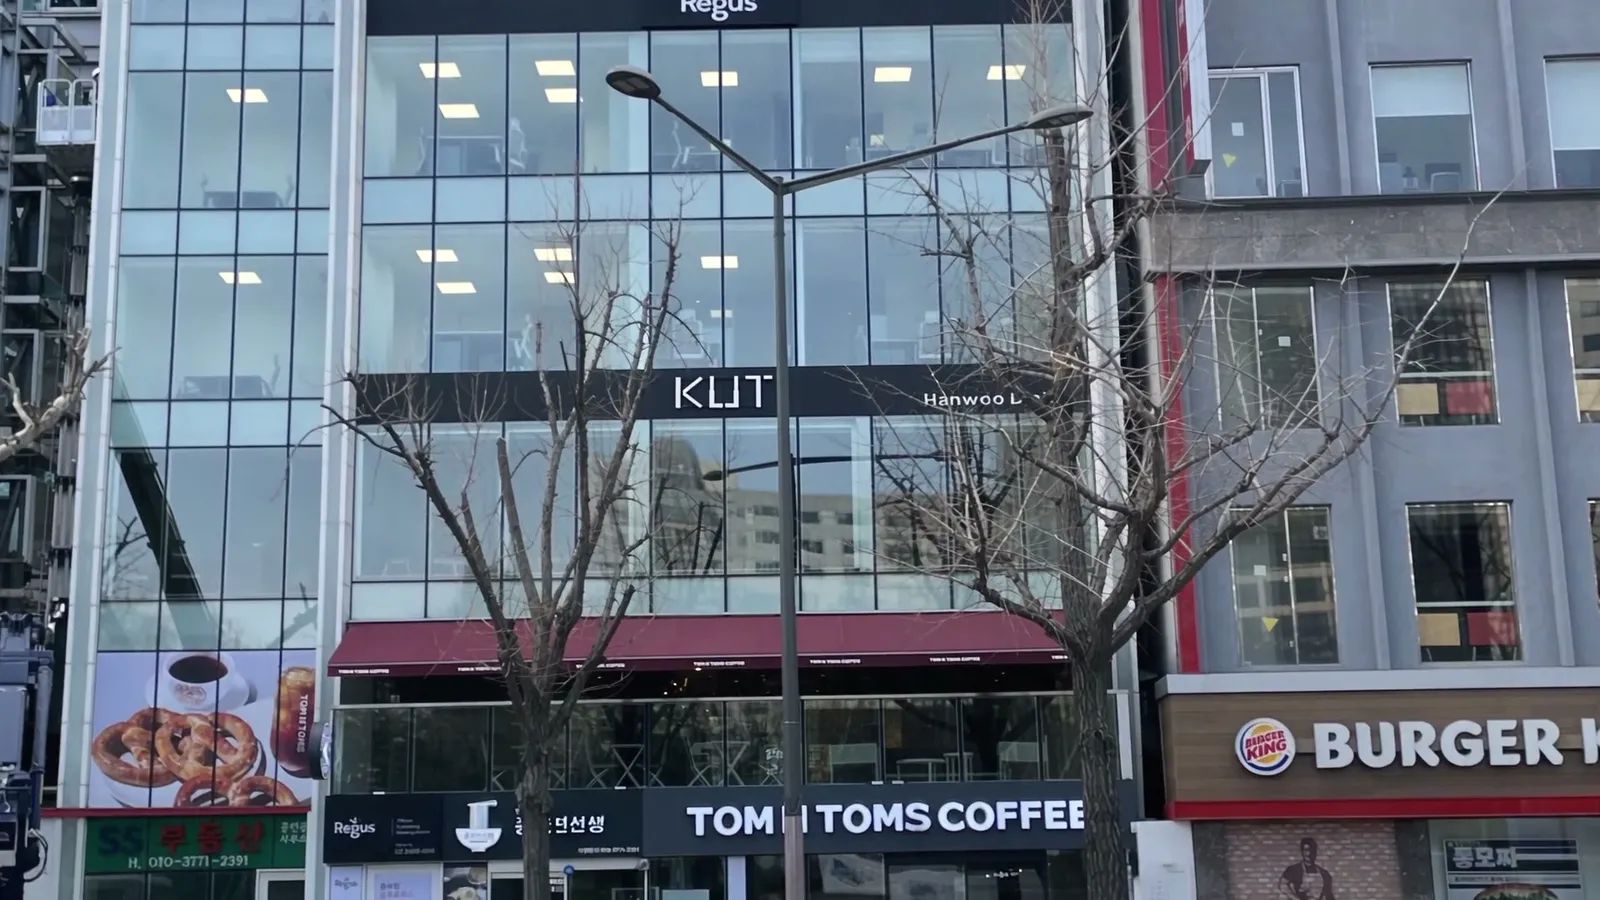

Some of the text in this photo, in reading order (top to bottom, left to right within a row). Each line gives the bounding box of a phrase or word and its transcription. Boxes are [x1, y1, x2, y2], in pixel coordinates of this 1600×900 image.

[680, 0, 758, 22] Regus
[675, 375, 773, 408] KUT
[924, 393, 1004, 406] Hanwoo
[1245, 730, 1285, 749] BURGER
[1246, 739, 1287, 761] KING
[1313, 719, 1564, 769] BURGER
[686, 805, 774, 836] TOM
[815, 802, 932, 834] TOMS
[937, 799, 1085, 832] COFFEE
[100, 825, 143, 853] SS
[334, 819, 376, 839] Regus
[148, 854, 249, 868] 010-3771-2391
